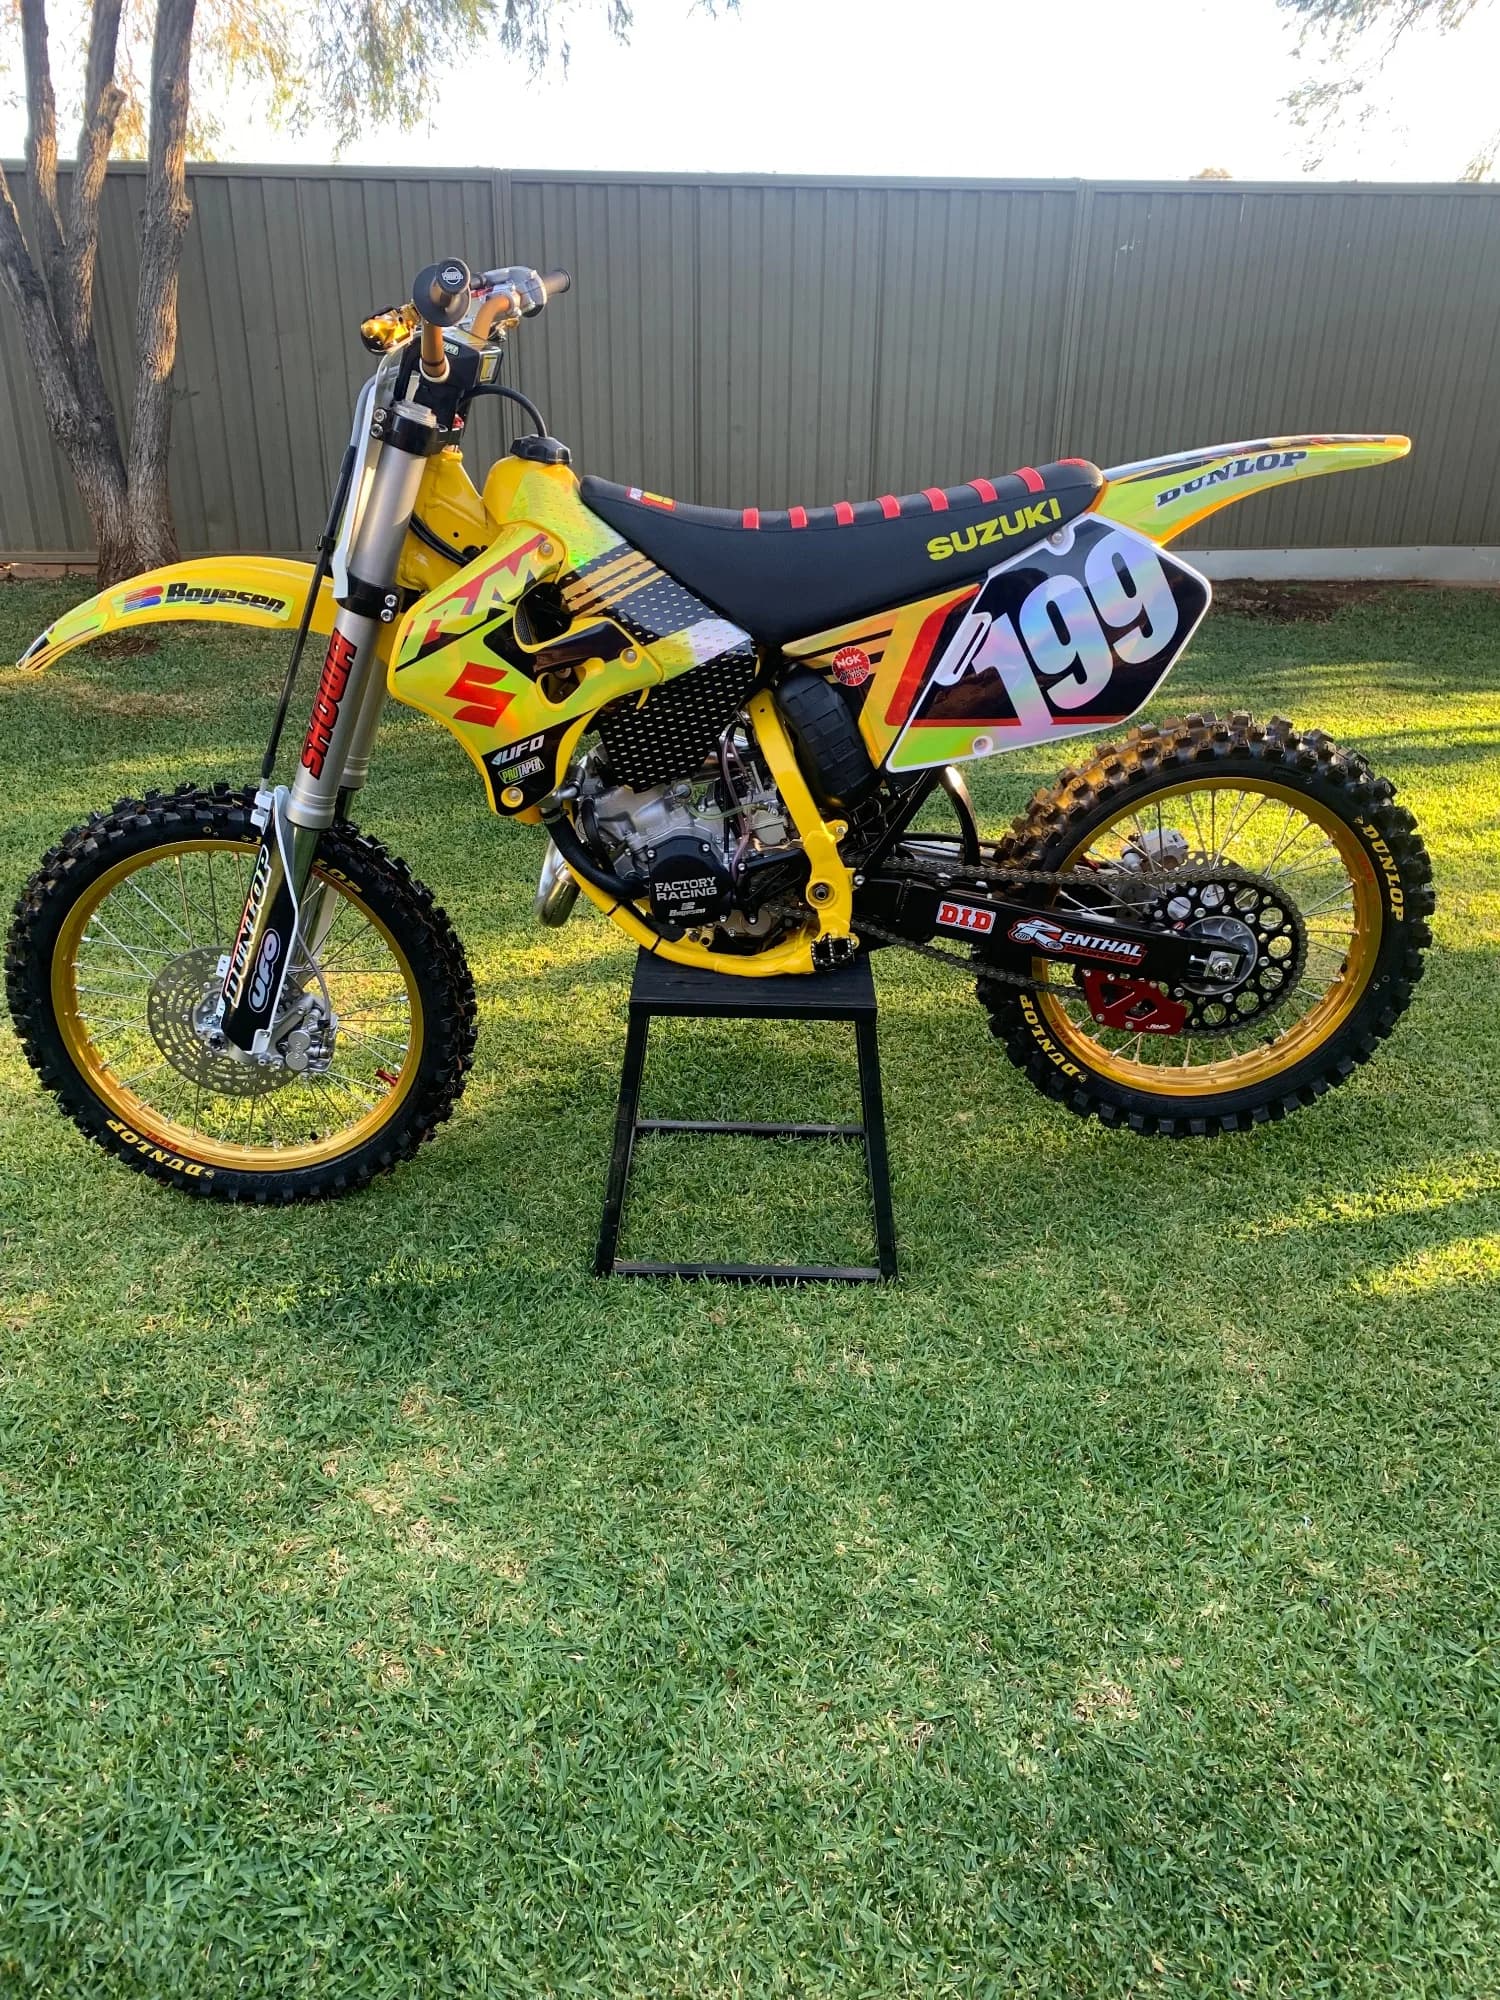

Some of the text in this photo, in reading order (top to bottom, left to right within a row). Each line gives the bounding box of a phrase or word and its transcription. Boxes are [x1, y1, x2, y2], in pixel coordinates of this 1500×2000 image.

[1157, 450, 1308, 508] DUNLOP
[927, 497, 1062, 561] SUZUKI
[165, 582, 286, 613] Boyesen
[970, 528, 1179, 727] 199
[836, 653, 862, 669] NGK
[301, 627, 358, 780] SHOWA
[495, 734, 545, 765] UFO
[501, 758, 543, 781] PROTAPER
[654, 876, 717, 892] FACTORY
[656, 886, 718, 901] RACING
[1362, 824, 1404, 922] DUNLOP
[224, 844, 272, 1008] DUNLOP
[249, 930, 280, 1011] UFO
[1019, 994, 1081, 1077] DUNLOP
[105, 1119, 205, 1177] DUNLOP
